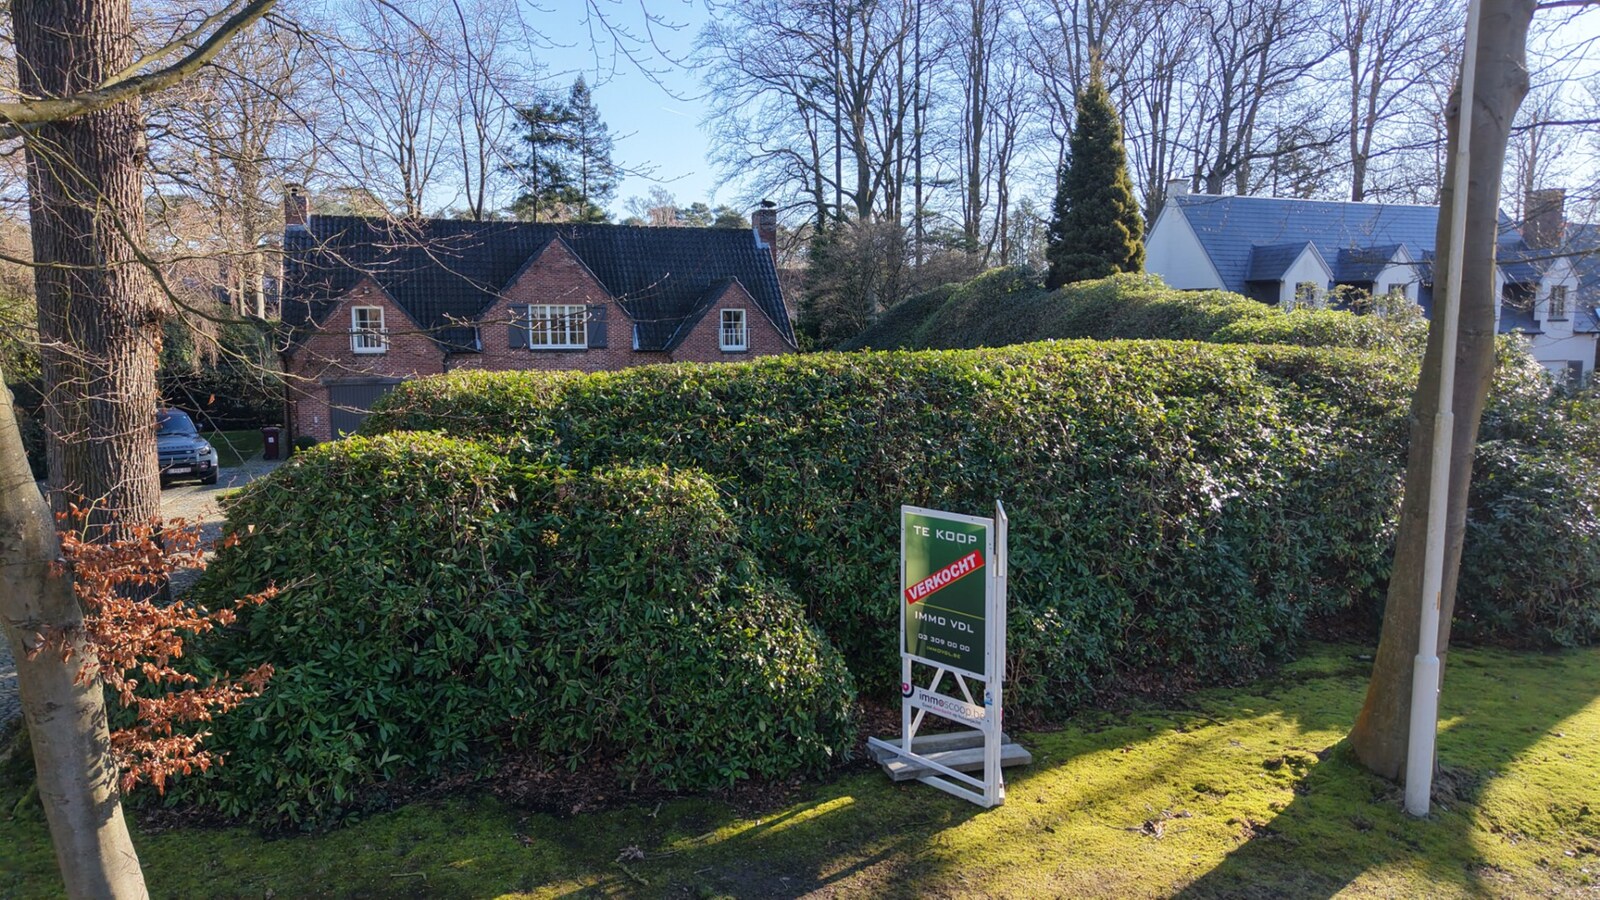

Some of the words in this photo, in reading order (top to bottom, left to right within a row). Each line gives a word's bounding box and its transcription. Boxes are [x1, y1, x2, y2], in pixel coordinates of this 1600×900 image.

[913, 525, 930, 537] TE
[936, 529, 977, 544] KOOP
[908, 553, 976, 600] VERKOCHT
[914, 611, 946, 626] IMMO
[950, 620, 974, 633] VDL
[918, 633, 928, 641] 03
[930, 637, 945, 645] 309
[947, 641, 958, 649] 00
[919, 690, 985, 719] immoscoop.be
